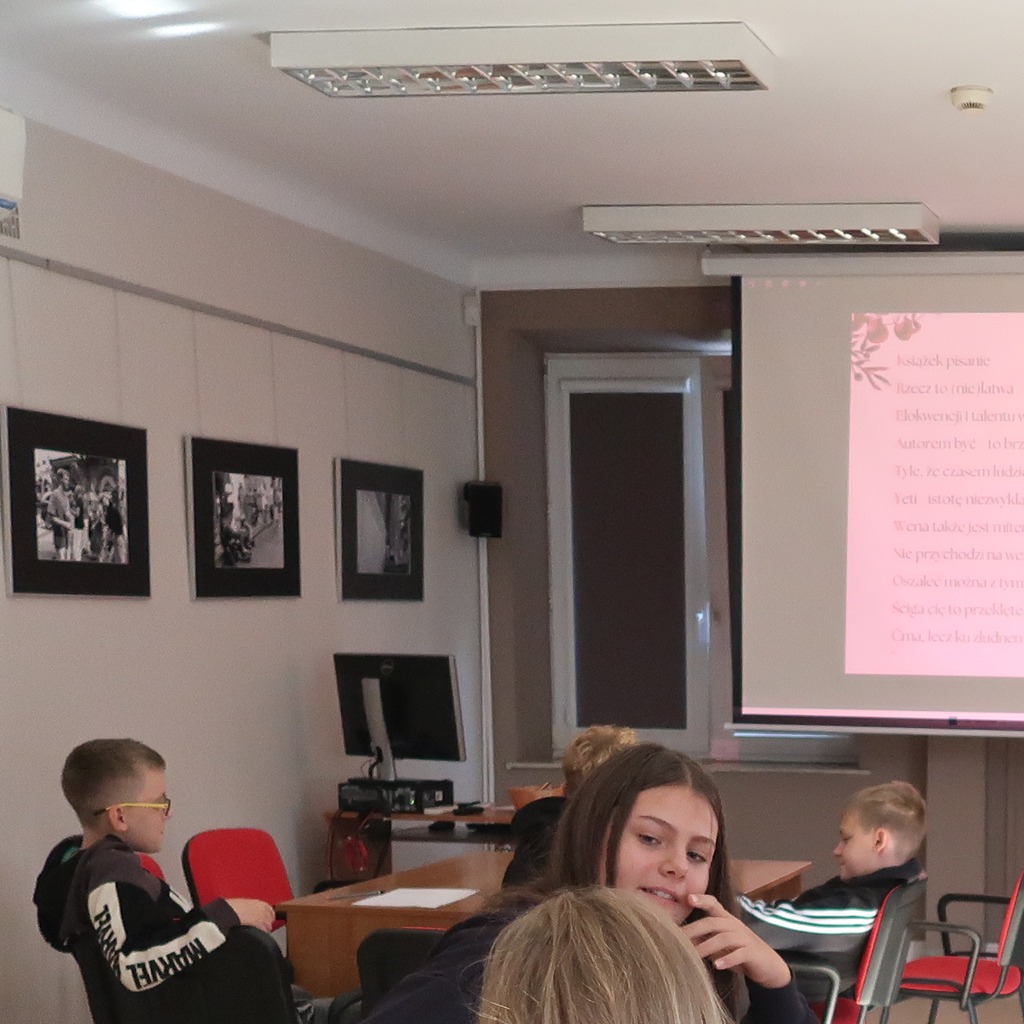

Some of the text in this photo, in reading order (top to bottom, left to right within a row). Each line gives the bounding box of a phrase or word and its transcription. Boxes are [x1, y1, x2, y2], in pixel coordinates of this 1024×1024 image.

[946, 354, 991, 370] pisanie
[935, 383, 948, 394] to
[971, 408, 1015, 422] talentu
[896, 437, 951, 450] Autorem
[988, 438, 1001, 450] to
[943, 466, 990, 478] czasem
[893, 519, 929, 533] Wena
[967, 521, 990, 536] jest
[894, 547, 912, 560] Nie
[915, 546, 984, 564] przychodzi
[987, 550, 1003, 561] na
[990, 578, 996, 589] z
[999, 577, 1024, 592] tym
[948, 604, 962, 616] to
[927, 629, 952, 643] lecz
[955, 630, 970, 643] ku
[125, 937, 206, 990] MARVEL
